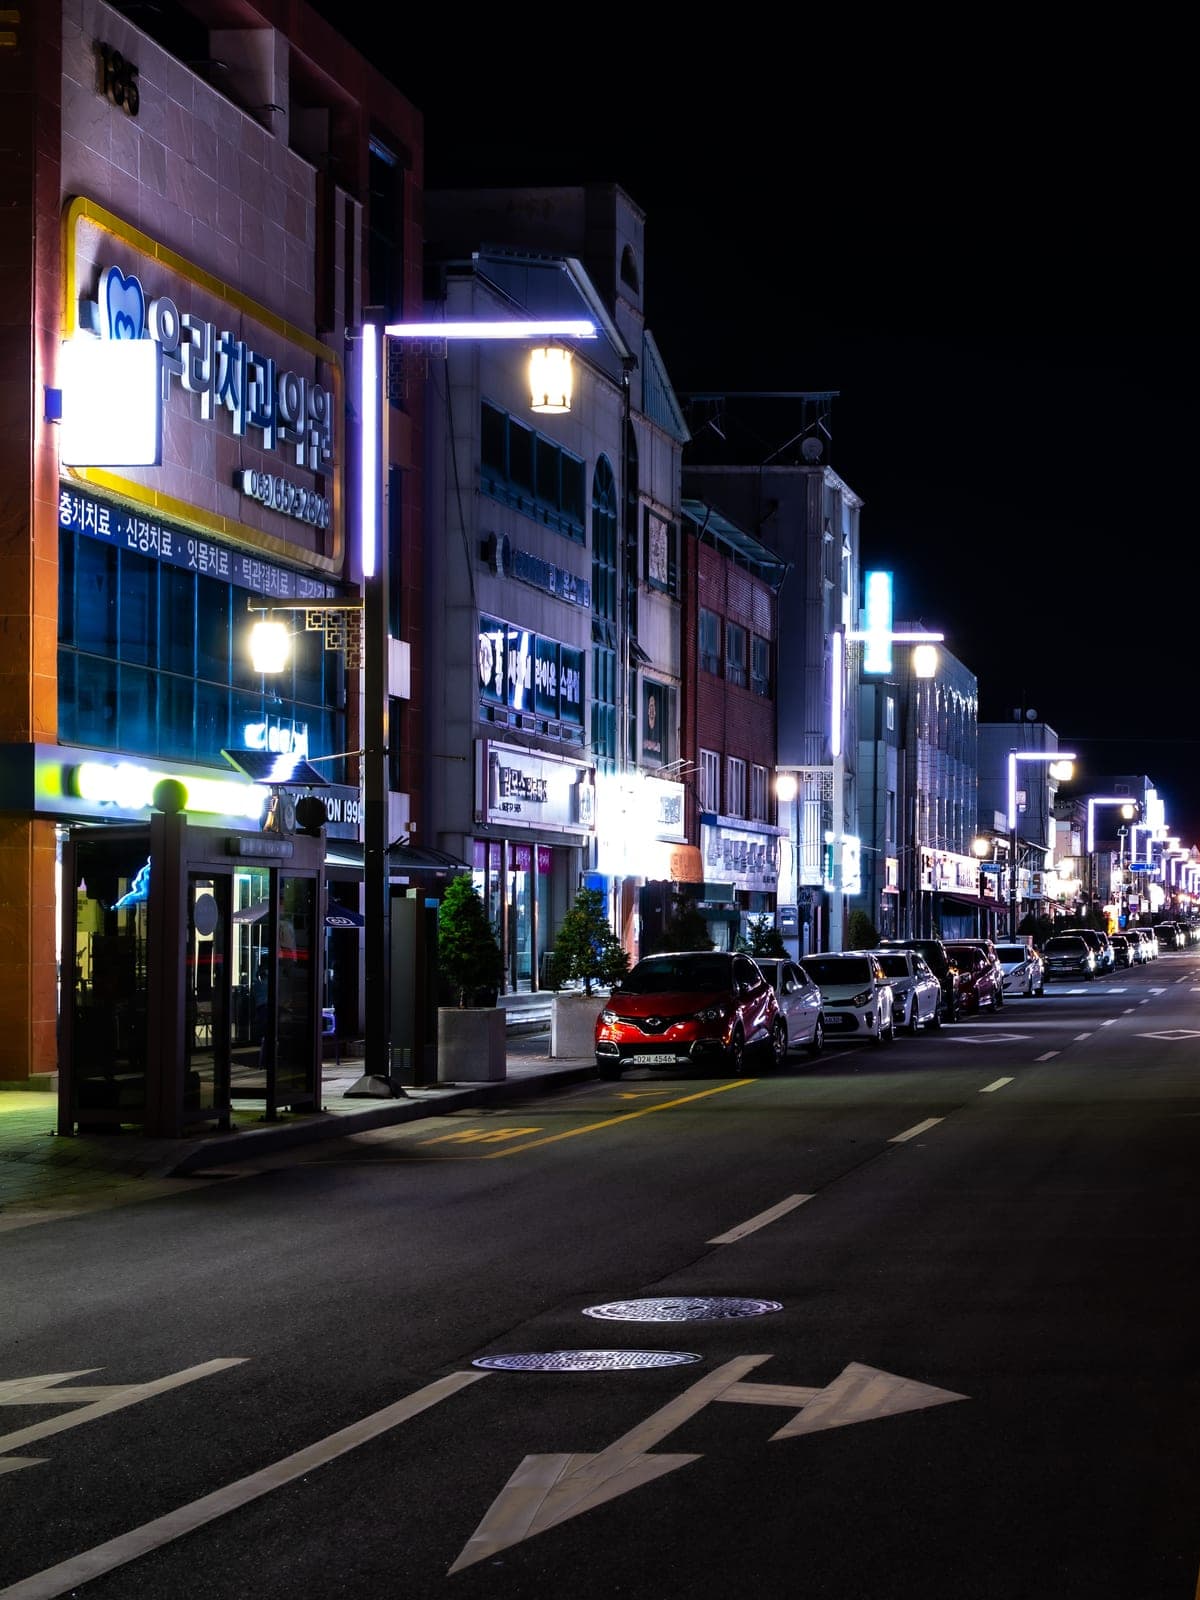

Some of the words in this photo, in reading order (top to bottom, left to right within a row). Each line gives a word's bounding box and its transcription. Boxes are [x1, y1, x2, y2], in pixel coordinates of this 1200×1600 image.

[149, 296, 335, 475] 우리치과의원
[126, 518, 173, 557] 신경치료
[187, 540, 230, 576] 잇몸치료
